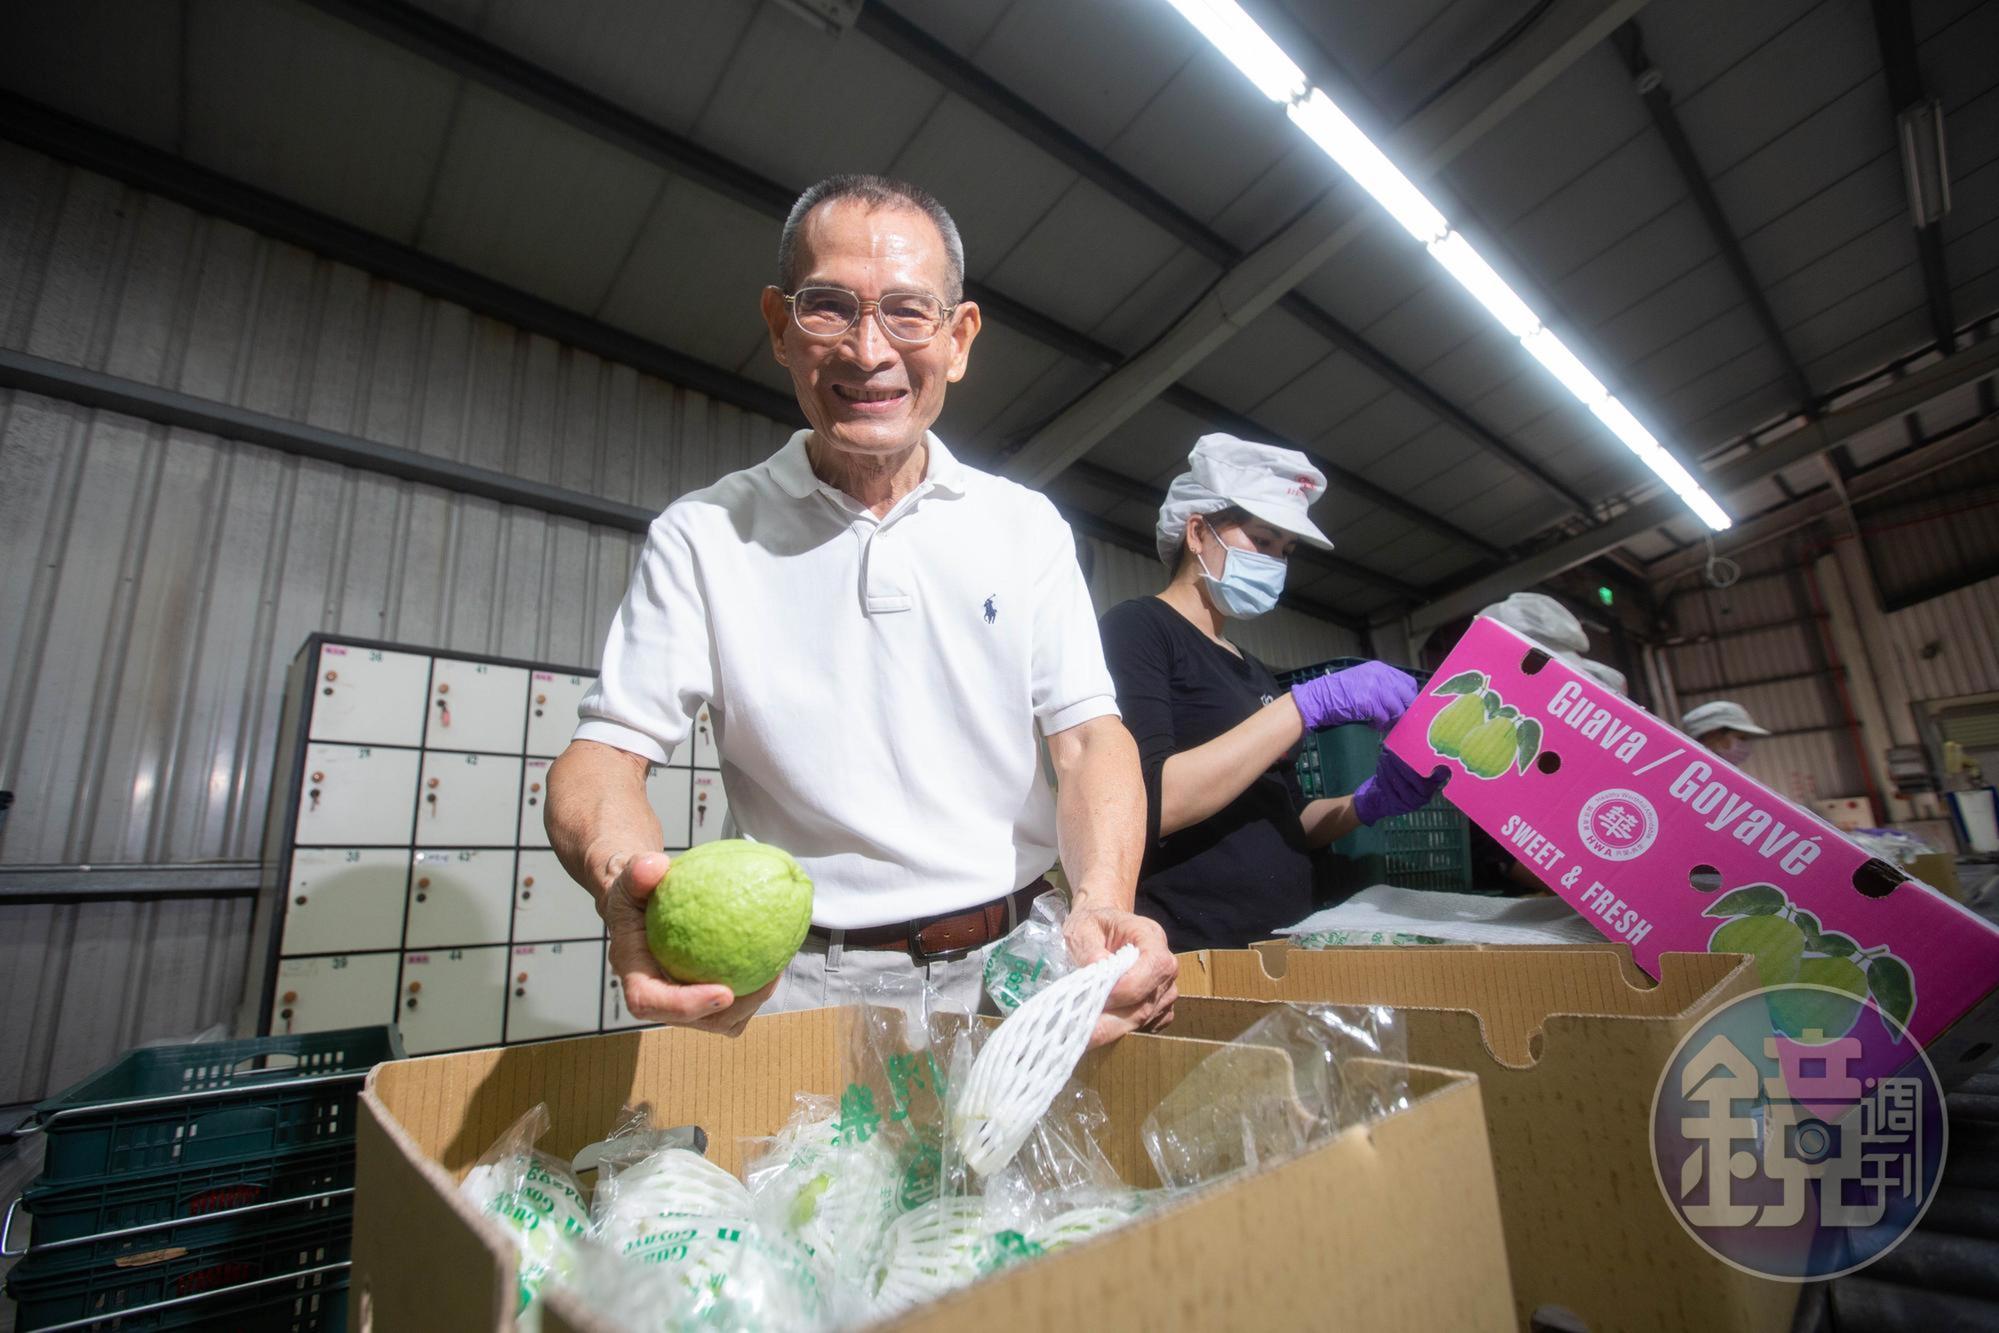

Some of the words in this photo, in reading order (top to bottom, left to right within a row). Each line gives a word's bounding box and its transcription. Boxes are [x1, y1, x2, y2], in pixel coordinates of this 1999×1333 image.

[1547, 680, 1649, 765] Guava
[1668, 761, 1822, 876] Goyavé
[1500, 814, 1566, 872] SWEET
[1560, 866, 1582, 889] &
[1580, 881, 1654, 946] FRESH
[1586, 835, 1612, 857] HWA
